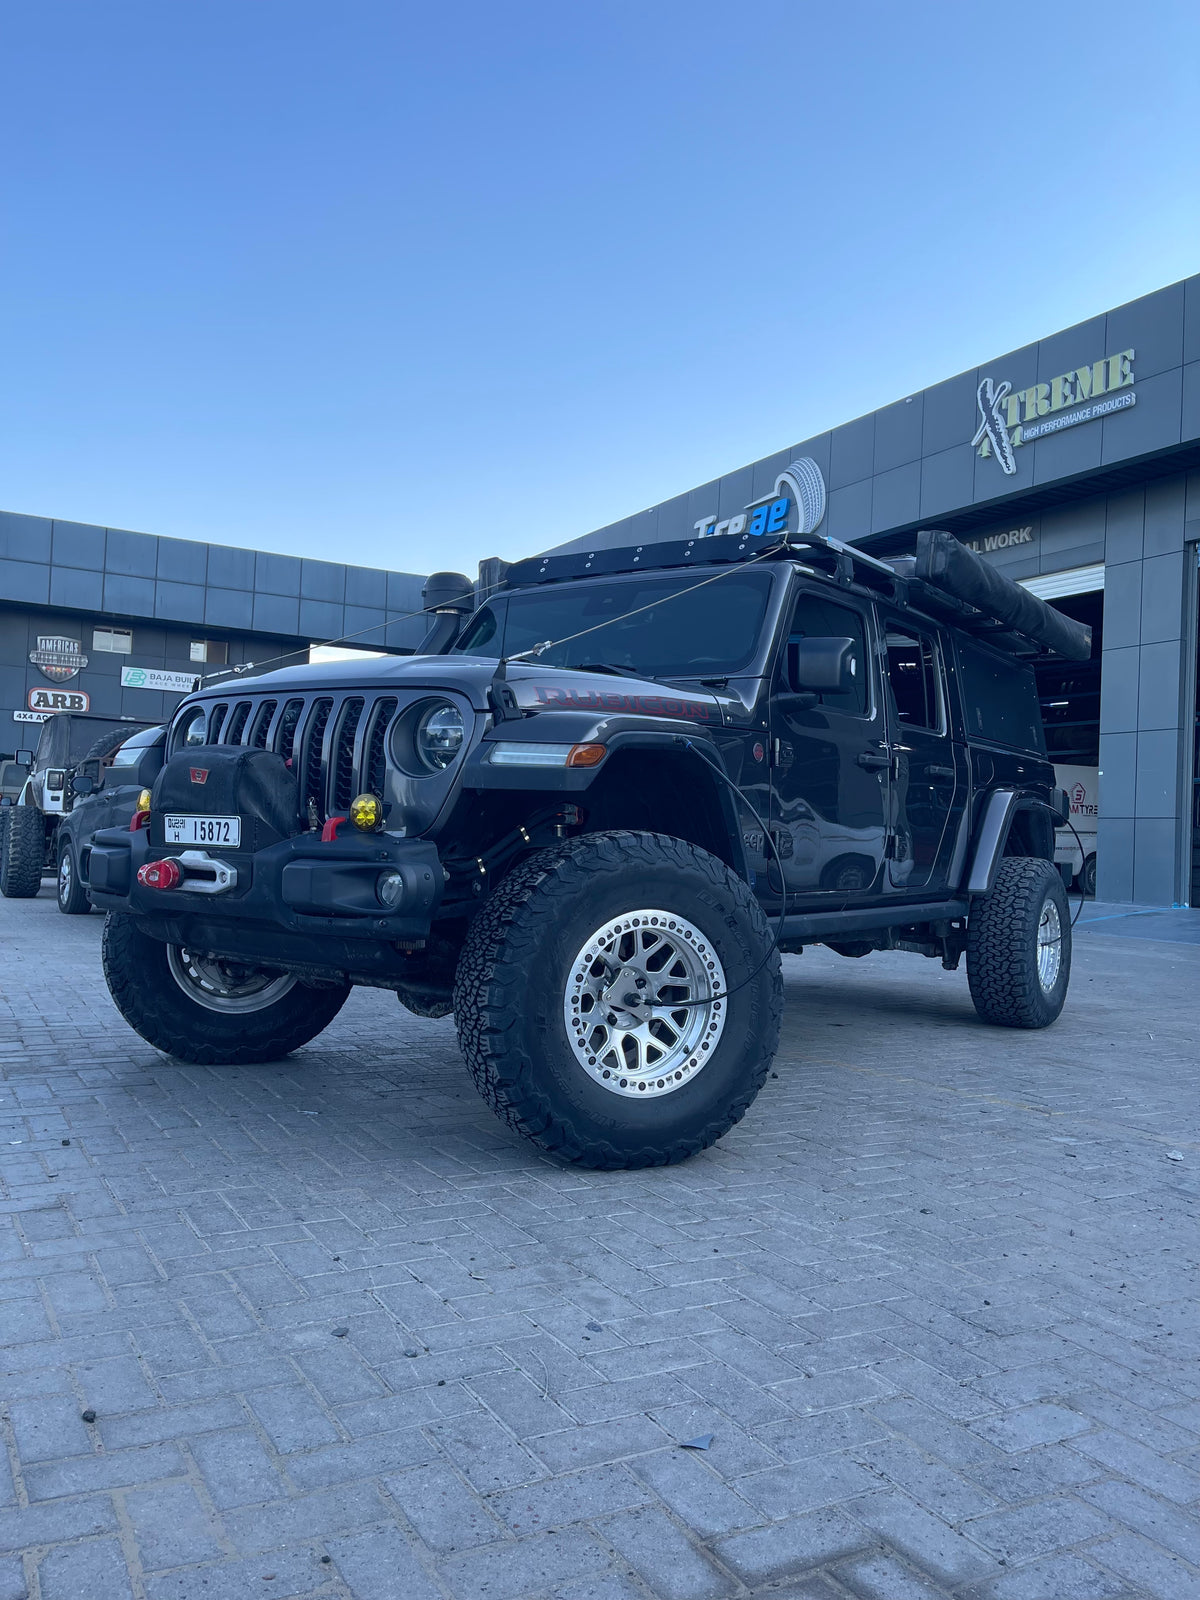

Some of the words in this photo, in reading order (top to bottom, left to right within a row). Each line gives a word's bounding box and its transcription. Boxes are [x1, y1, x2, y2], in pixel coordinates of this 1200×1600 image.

[1023, 426, 1040, 440] HIGH
[1040, 407, 1091, 434] PERFORMANCE
[1091, 394, 1132, 417] PRODUCTS
[984, 527, 1033, 552] WORK
[41, 639, 79, 655] AMERICAS
[149, 673, 173, 682] BAJA
[175, 675, 197, 684] BUIL
[33, 691, 84, 711] ARB
[533, 686, 710, 719] RUBICON
[16, 712, 33, 720] 4X4
[174, 831, 180, 842] H
[194, 820, 230, 843] 15872
[743, 833, 764, 852] eep
